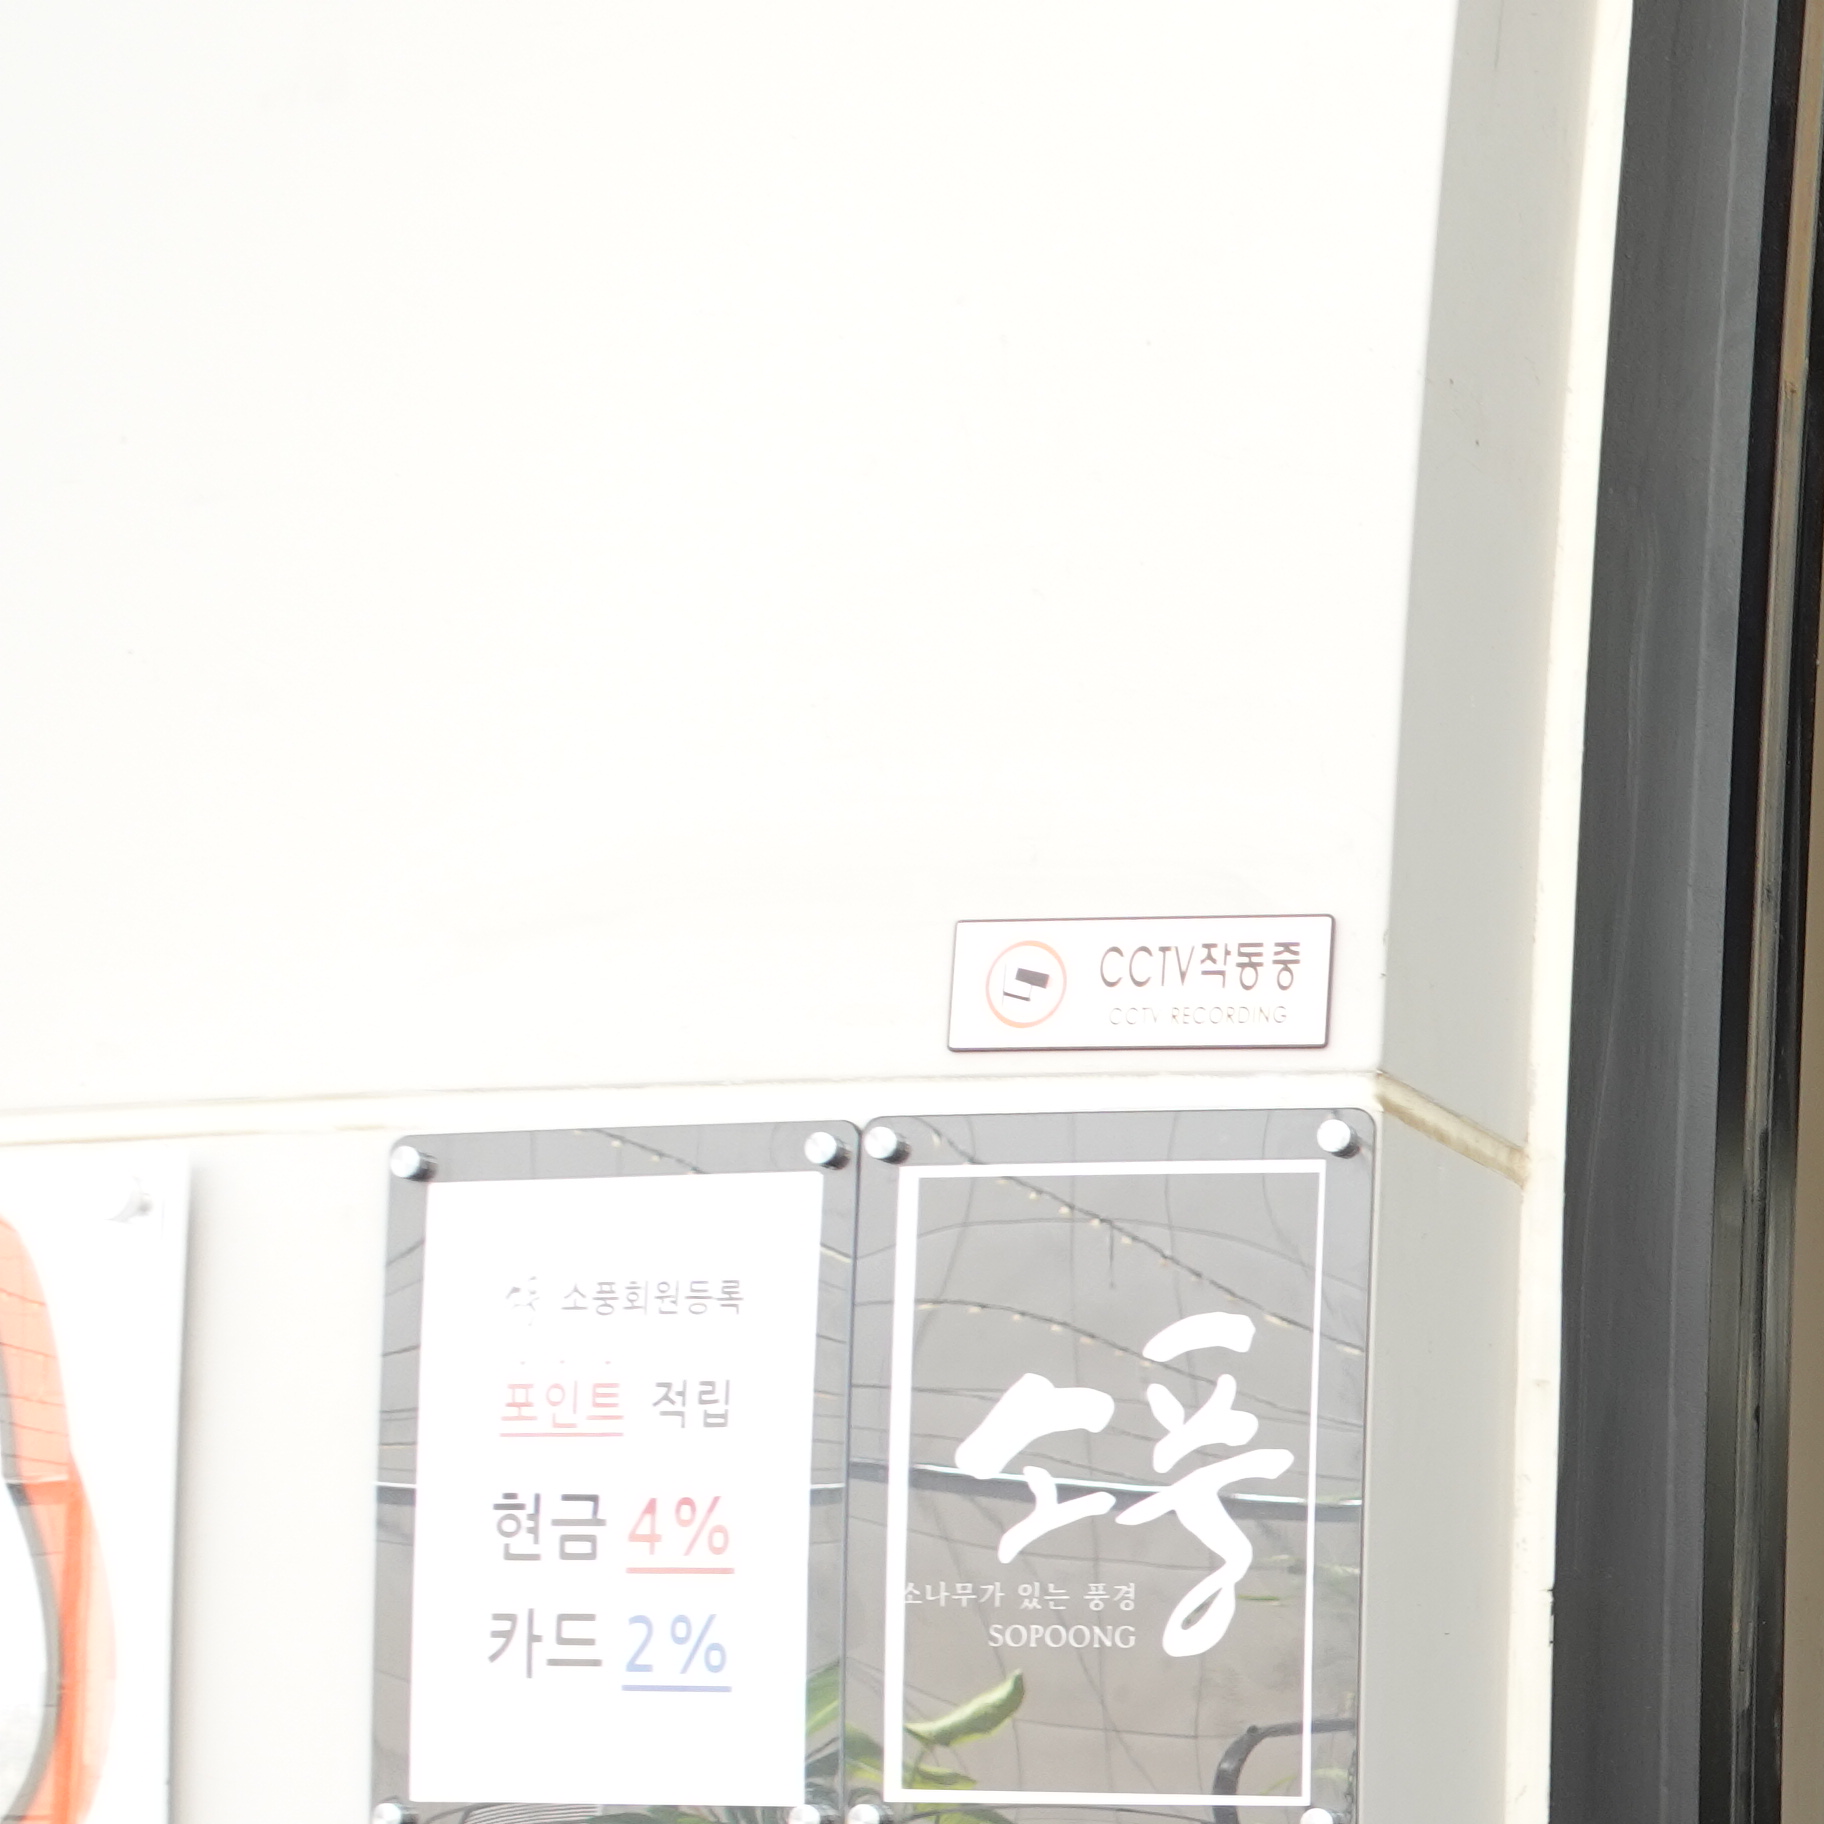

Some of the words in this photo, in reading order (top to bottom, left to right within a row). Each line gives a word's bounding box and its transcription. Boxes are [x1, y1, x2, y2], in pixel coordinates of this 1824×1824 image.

[1099, 941, 1301, 991] CCTV작동중
[1108, 1006, 1161, 1025] CCTV
[1171, 1005, 1288, 1025] RECORDING
[560, 1279, 745, 1316] 소풍회원등록
[500, 1379, 625, 1429] 포인트
[652, 1378, 731, 1428] 적립
[492, 1491, 607, 1562] 현금
[627, 1494, 731, 1556] 4%
[904, 1581, 1005, 1608] 소나무가
[1018, 1582, 1070, 1610] 있는
[1083, 1583, 1136, 1611] 풍경
[487, 1607, 603, 1679] 카드
[624, 1613, 728, 1675] 2%
[988, 1624, 1136, 1648] SOPOONG
